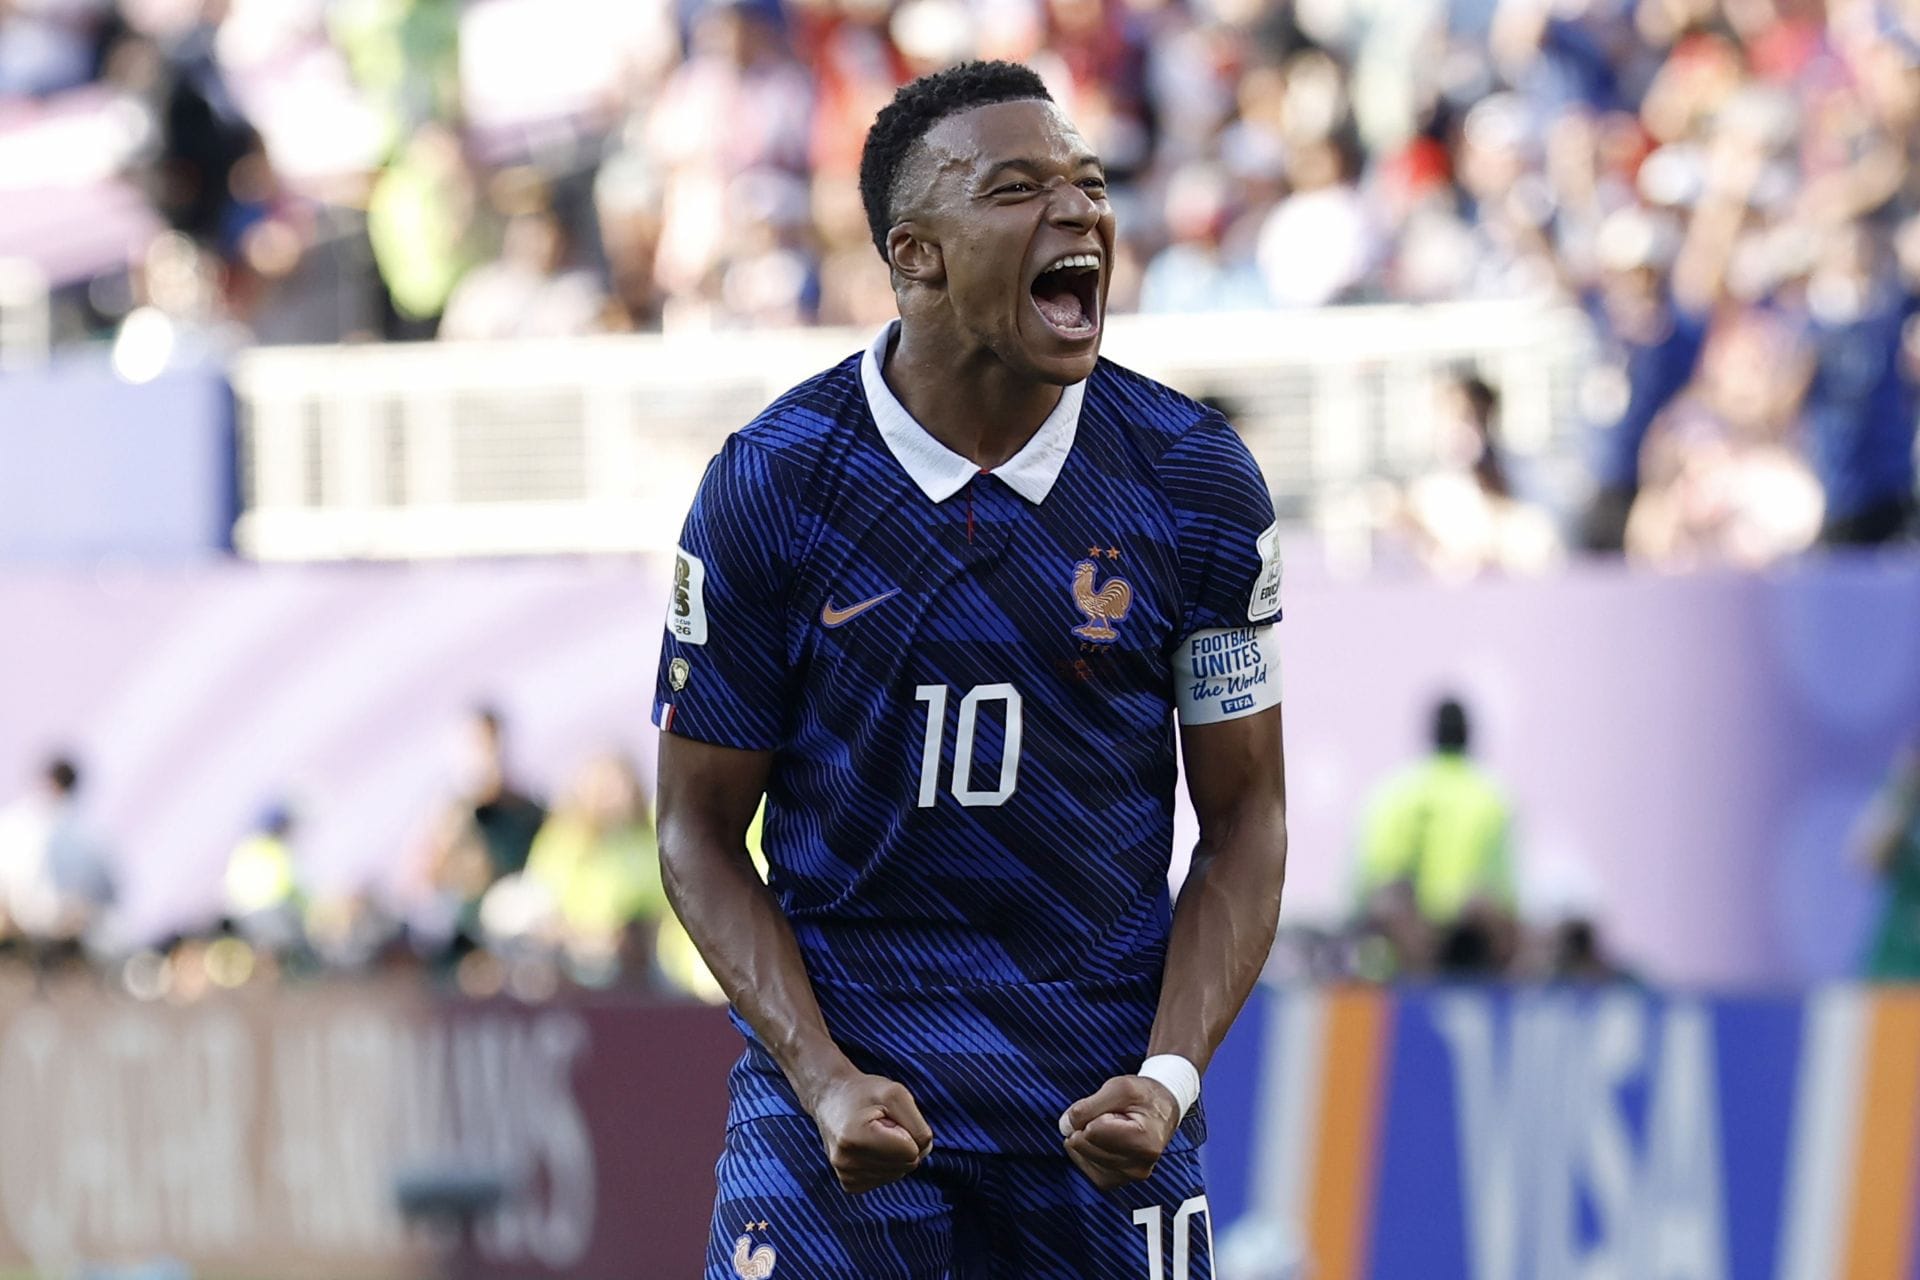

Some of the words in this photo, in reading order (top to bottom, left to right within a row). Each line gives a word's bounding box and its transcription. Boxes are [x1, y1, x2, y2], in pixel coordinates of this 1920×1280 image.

[675, 625, 692, 636] 26
[1191, 626, 1257, 656] FOOTBALL
[1191, 641, 1261, 679] UNITES
[1189, 680, 1224, 701] the
[1227, 663, 1267, 695] World
[1223, 696, 1253, 712] FIFA
[914, 682, 1023, 808] 10
[1132, 1194, 1217, 1280] 10
